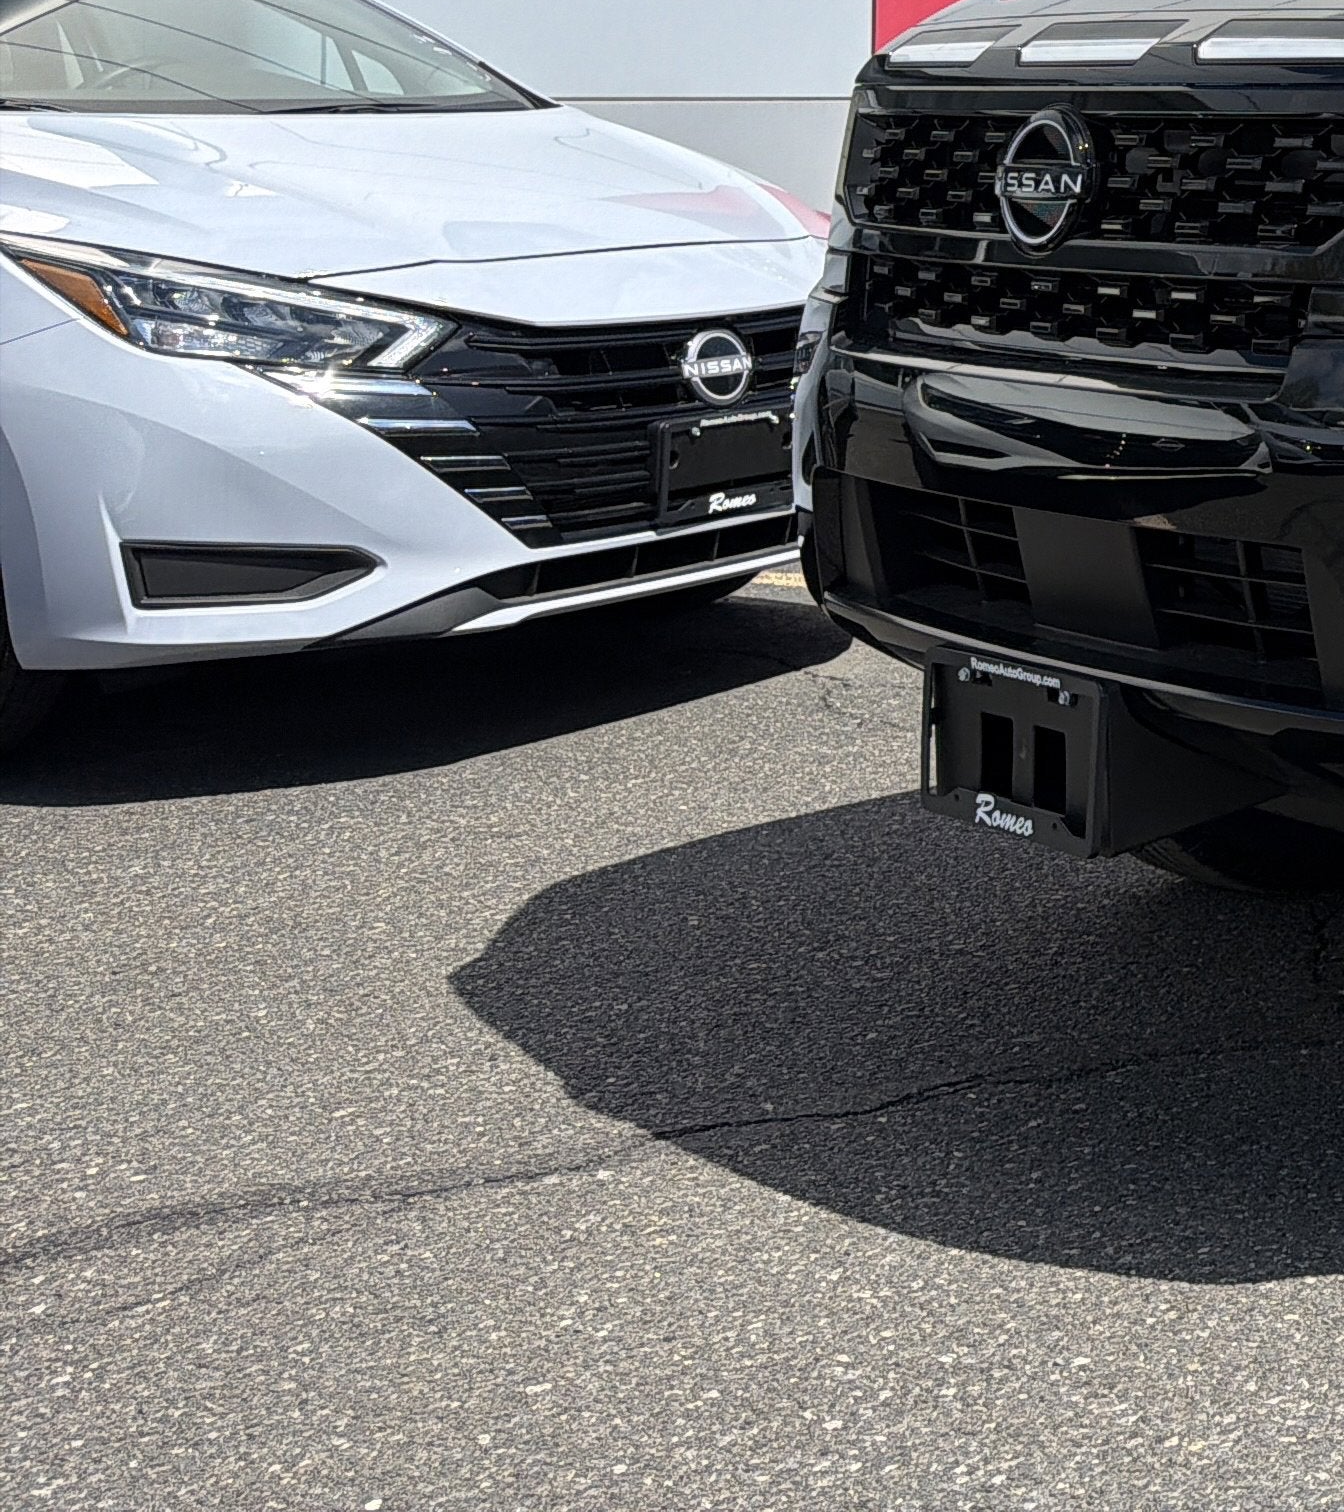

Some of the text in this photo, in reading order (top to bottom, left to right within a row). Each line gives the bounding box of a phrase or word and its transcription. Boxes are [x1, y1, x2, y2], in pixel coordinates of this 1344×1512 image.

[683, 356, 752, 378] NISSAN
[708, 491, 757, 515] Romeo
[970, 656, 1061, 689] RomeoAutoGroup.com
[974, 792, 1035, 837] Romeo
